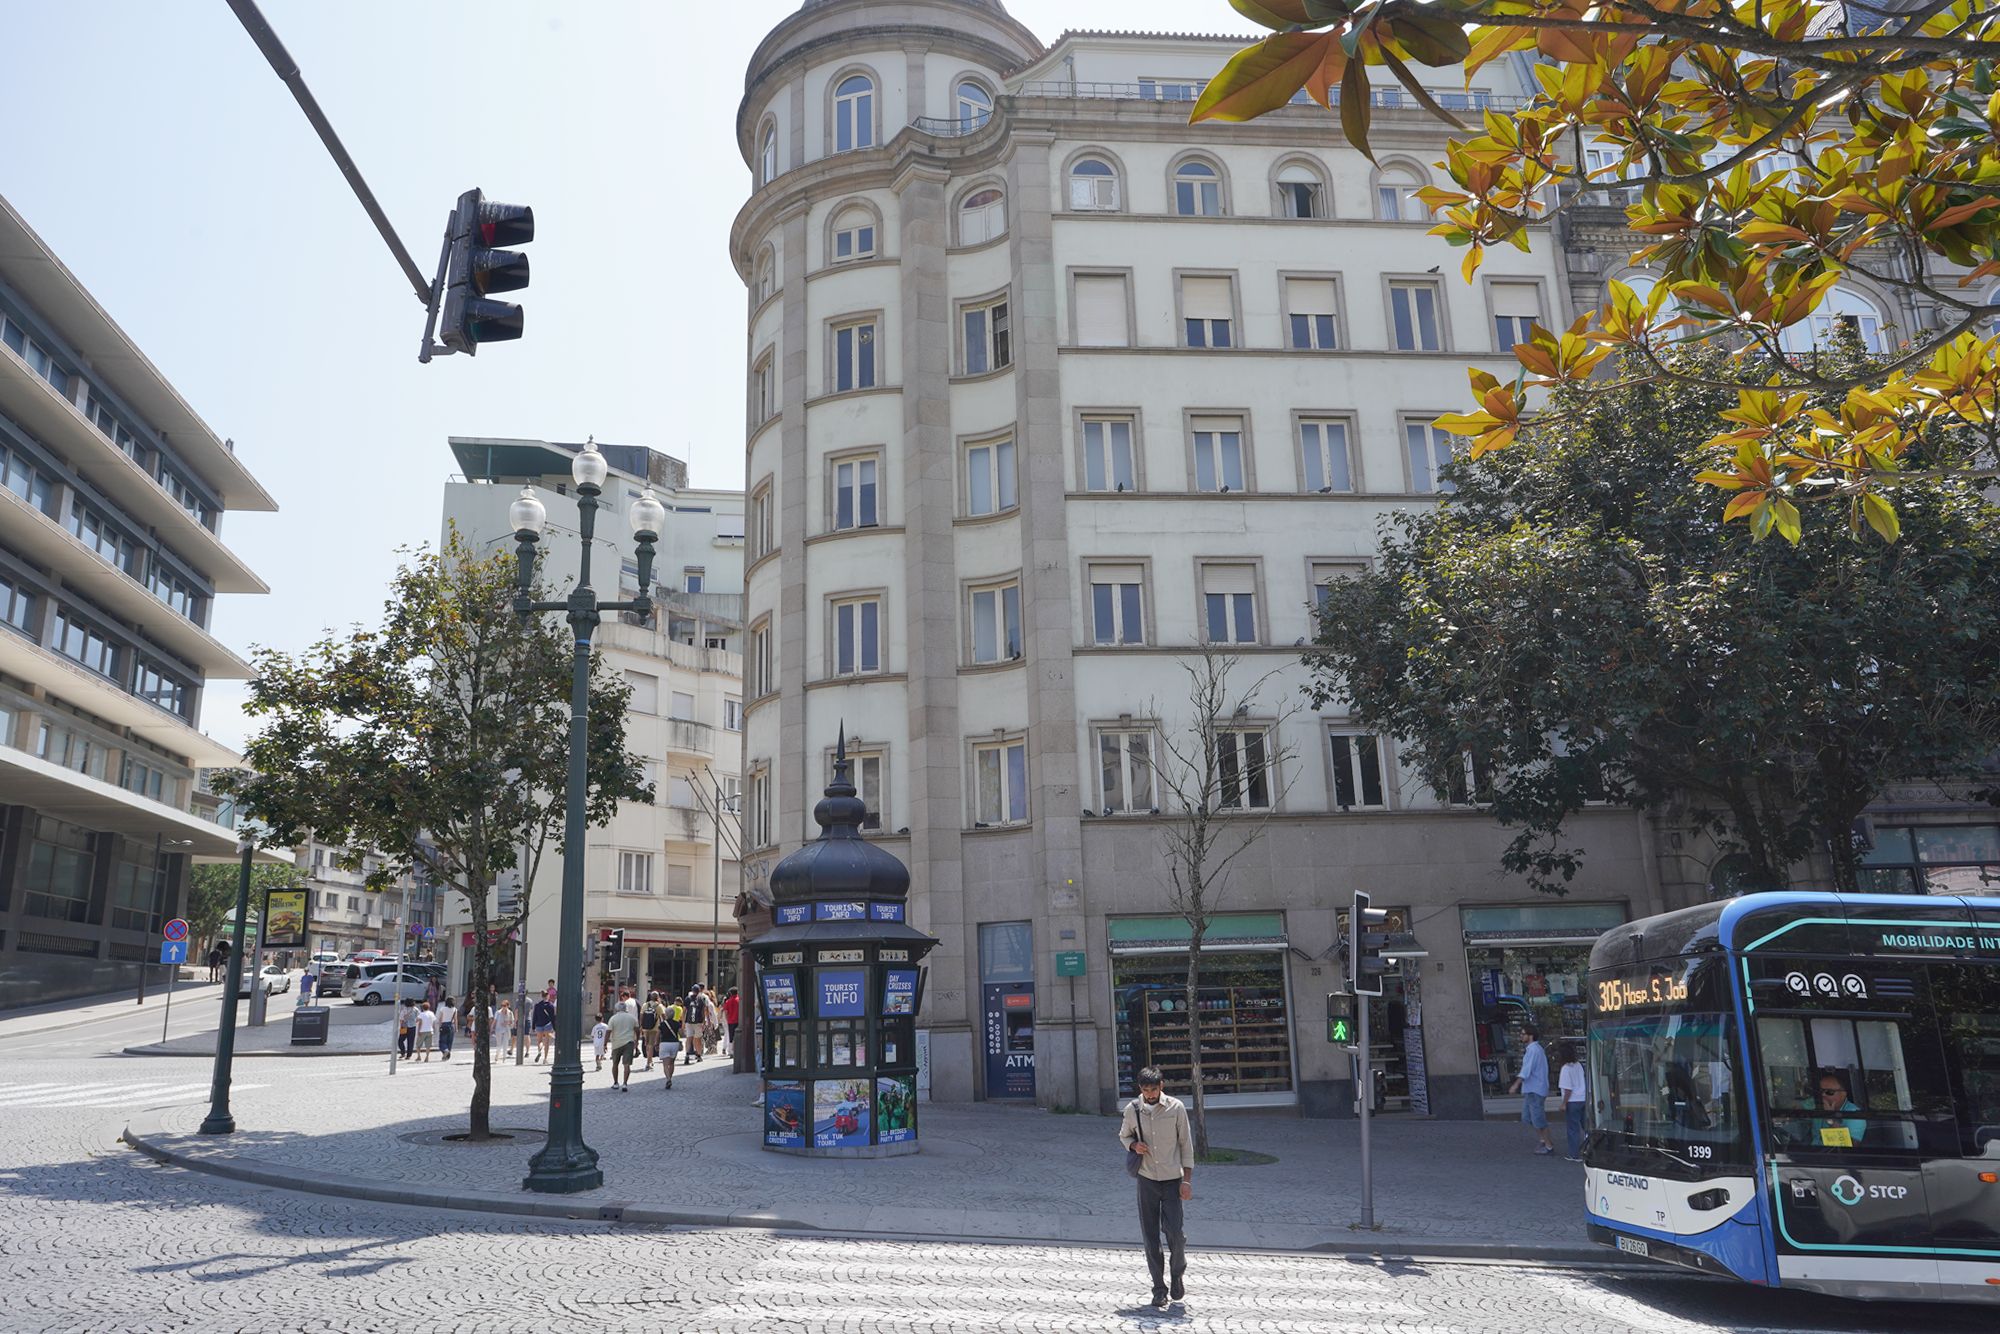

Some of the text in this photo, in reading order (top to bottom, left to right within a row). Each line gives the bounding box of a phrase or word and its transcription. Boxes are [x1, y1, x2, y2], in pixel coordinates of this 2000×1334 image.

[783, 907, 805, 916] TOURIST
[876, 905, 898, 913] TOURIST
[787, 914, 801, 922] INFO
[831, 911, 850, 919] INFO
[881, 912, 894, 920] INFO
[1882, 934, 1975, 949] MOBILIDADE
[765, 978, 791, 987] TUK TUK
[888, 982, 911, 990] CRUISES
[825, 992, 858, 1004] INFO
[1599, 977, 1689, 1012] 305 Hosp. S. Joã
[1005, 1055, 1035, 1067] ATM
[1688, 1146, 1711, 1158] 1399
[1607, 1173, 1648, 1190] CAETANO
[1869, 1186, 1908, 1198] STCP
[1656, 1211, 1666, 1221] TP
